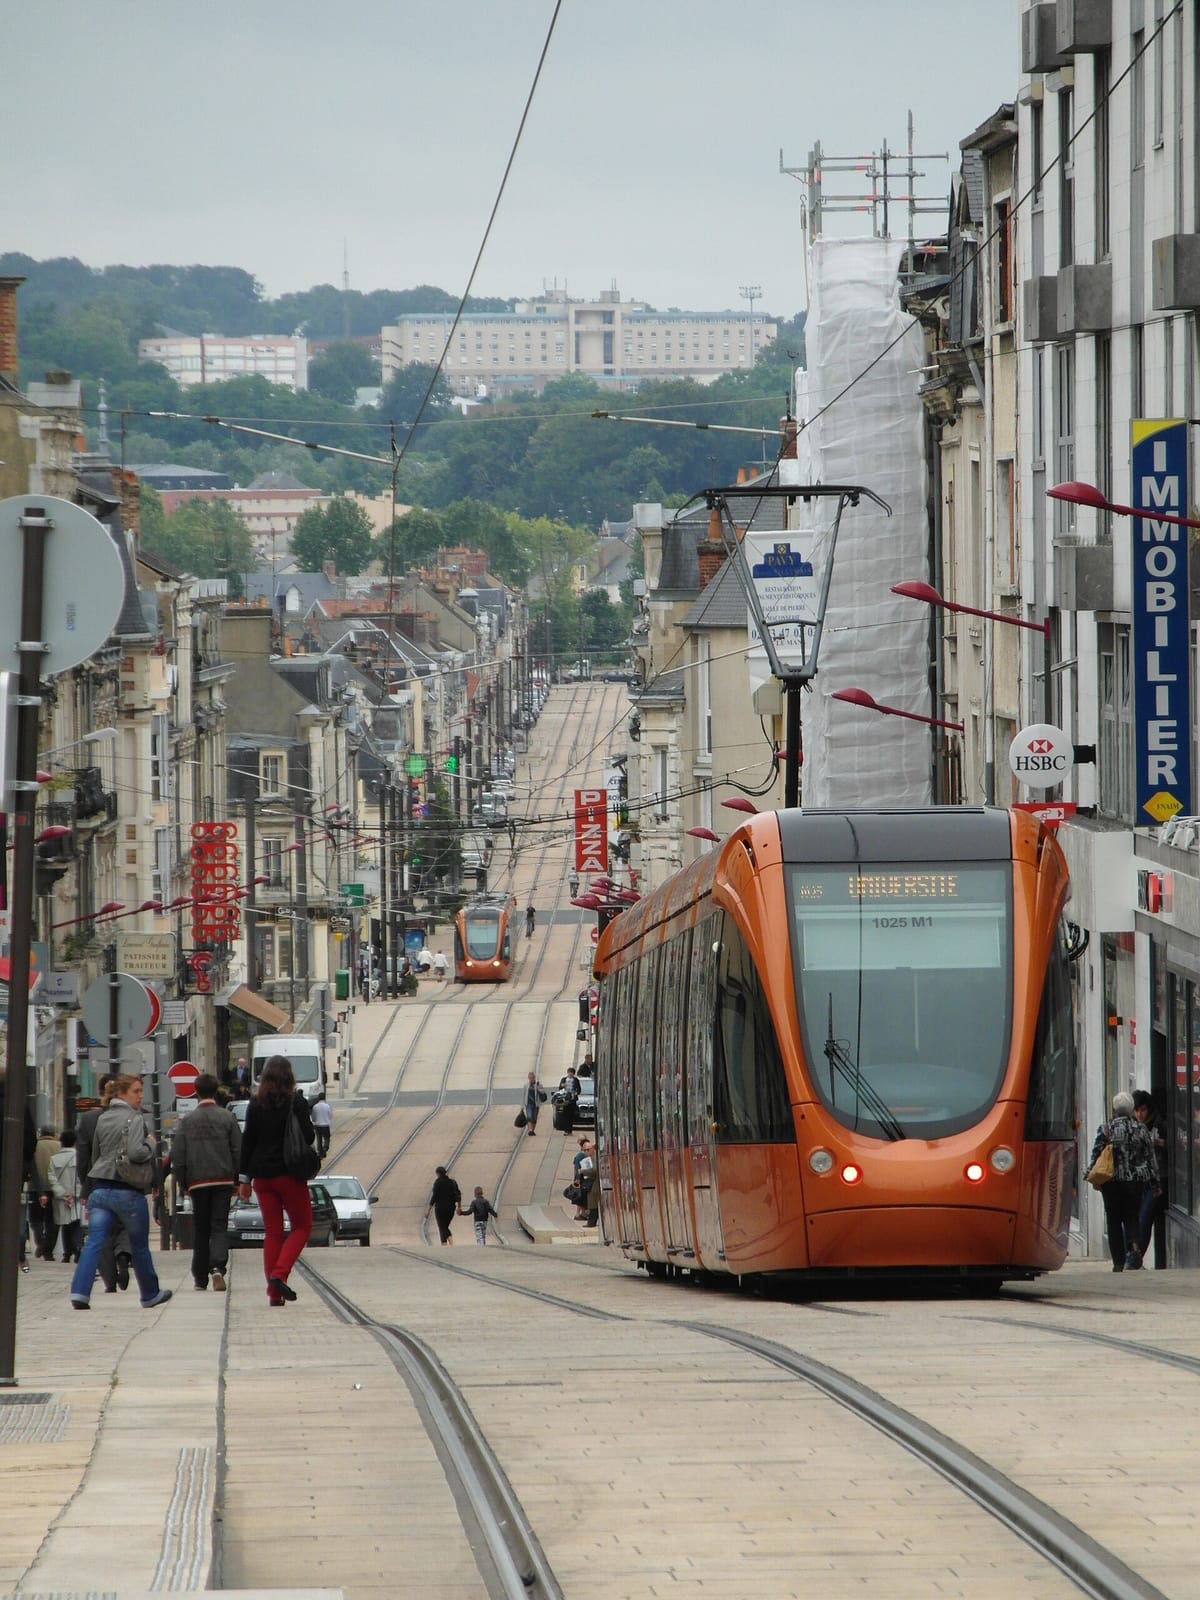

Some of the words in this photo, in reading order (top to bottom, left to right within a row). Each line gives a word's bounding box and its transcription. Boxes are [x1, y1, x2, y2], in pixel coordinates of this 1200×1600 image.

[768, 555, 795, 566] PAVY
[1141, 440, 1179, 786] IMMOBILIER
[1015, 755, 1066, 771] HSBC
[580, 791, 604, 871] PIZZA
[848, 875, 959, 897] UNIVERSITE
[872, 917, 908, 929] 1025
[911, 916, 933, 928] M1
